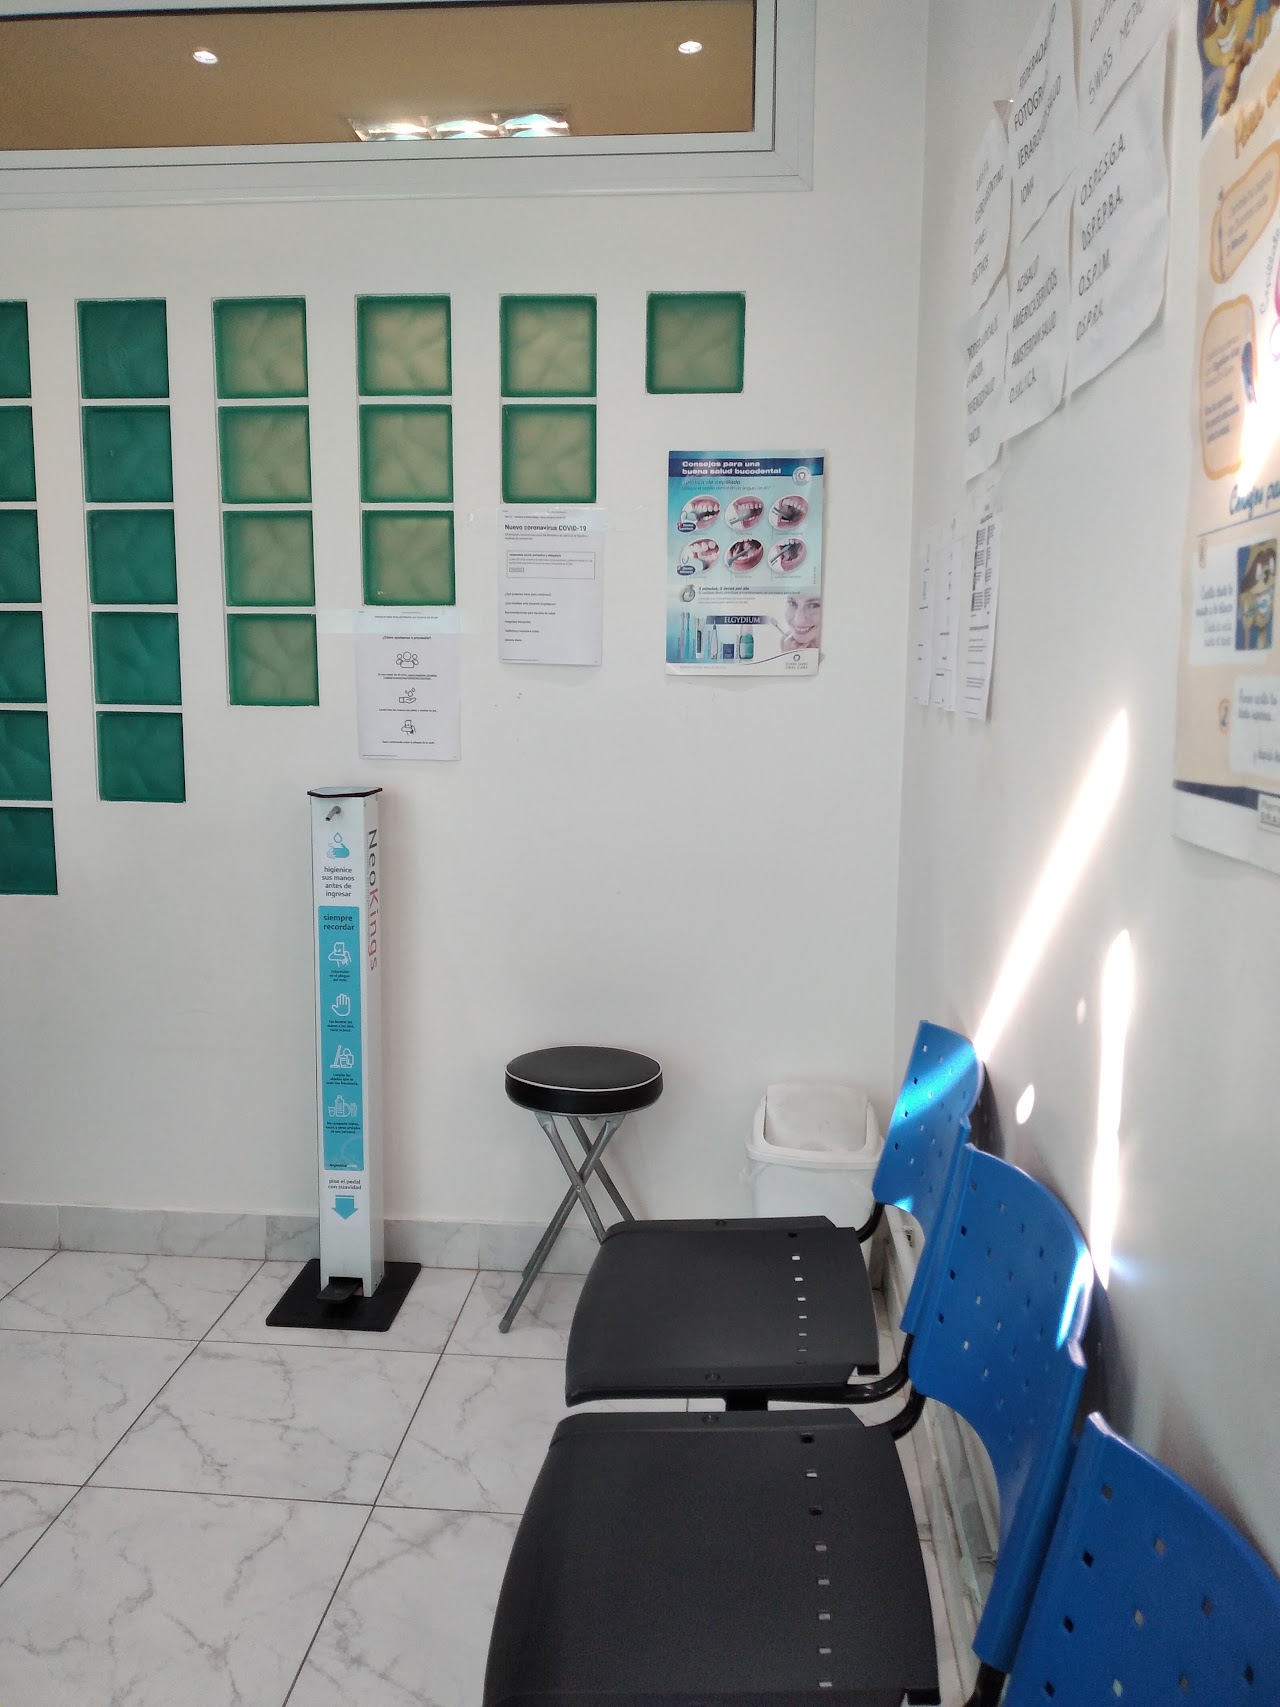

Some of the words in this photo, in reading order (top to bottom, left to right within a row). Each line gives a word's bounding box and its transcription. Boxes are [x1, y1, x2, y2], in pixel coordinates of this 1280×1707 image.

[1088, 46, 1114, 104] SWISS
[724, 616, 761, 624] ELGYDIUM
[323, 866, 352, 874] higienice
[323, 914, 353, 922] siempre
[323, 923, 355, 931] recordar
